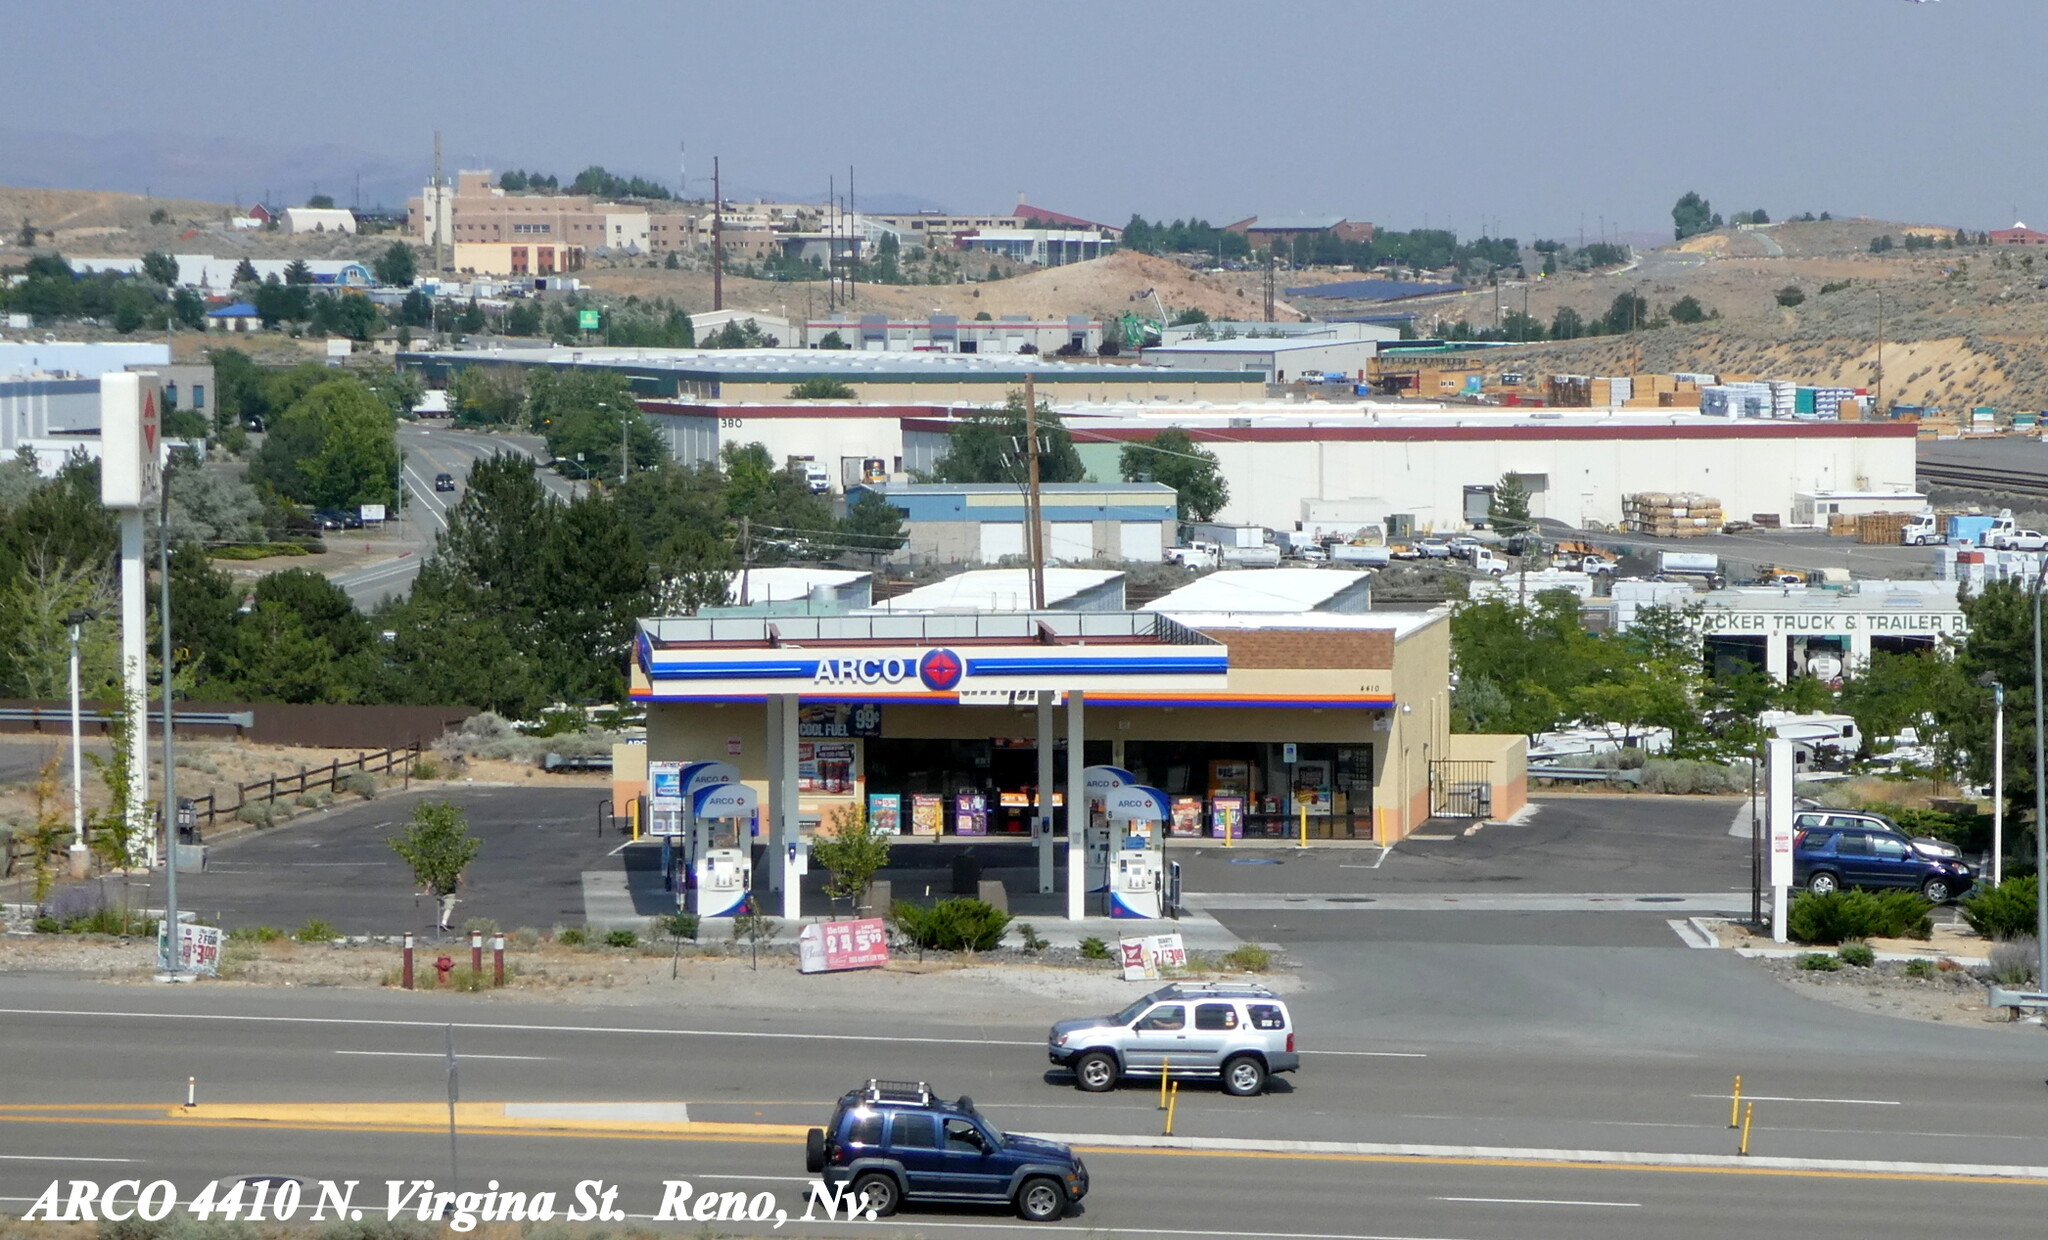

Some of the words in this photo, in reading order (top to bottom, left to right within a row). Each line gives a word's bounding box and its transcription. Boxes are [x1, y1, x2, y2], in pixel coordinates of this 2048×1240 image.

[721, 418, 743, 428] 380
[1691, 615, 1765, 630] PACKER
[1773, 615, 1836, 630] TRUCK
[1846, 615, 1857, 629] &
[1867, 615, 1943, 630] TRAILER
[814, 656, 905, 685] ARCO
[799, 723, 824, 736] COOL
[825, 723, 849, 737] FUEL
[695, 775, 719, 783] ARCO
[709, 797, 735, 805] ARCO
